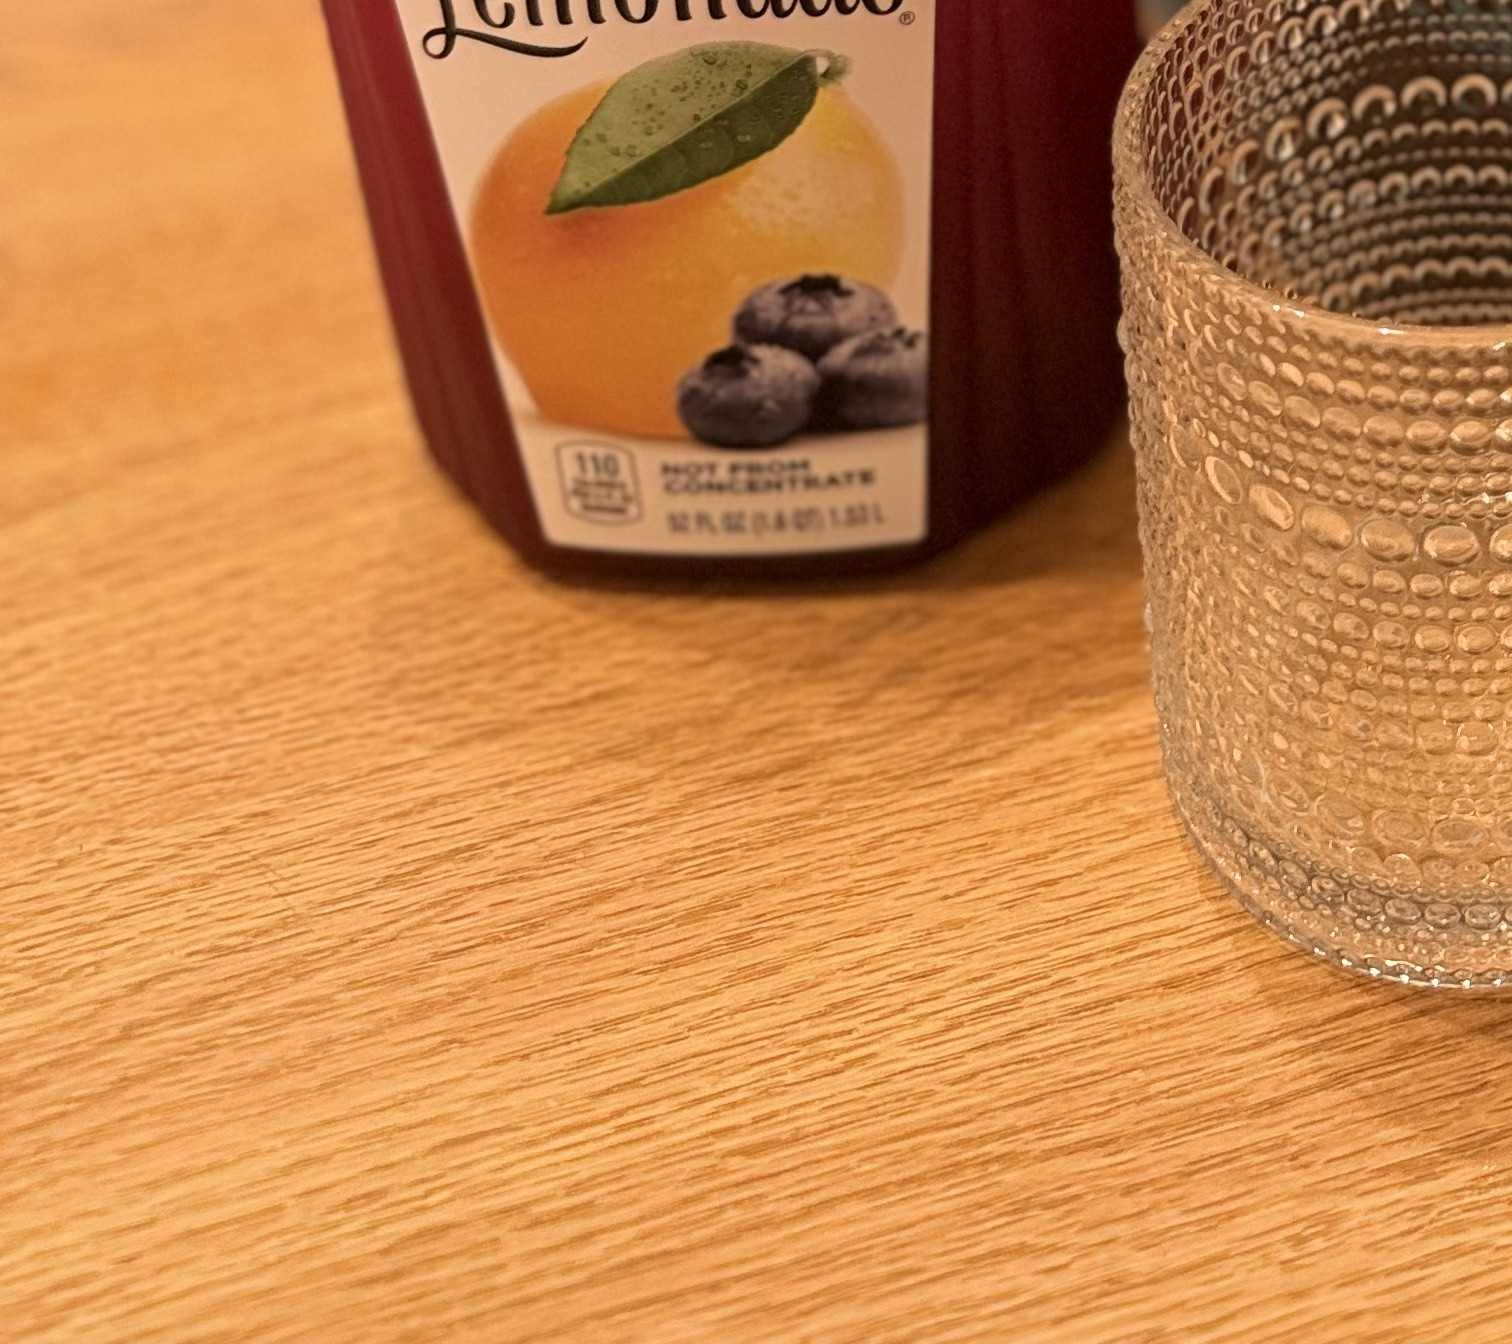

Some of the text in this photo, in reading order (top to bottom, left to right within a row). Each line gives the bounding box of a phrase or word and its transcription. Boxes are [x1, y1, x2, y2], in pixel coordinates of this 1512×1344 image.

[573, 450, 621, 478] 110
[660, 458, 811, 477] NOT FROM
[663, 467, 877, 495] CONCENTRATE
